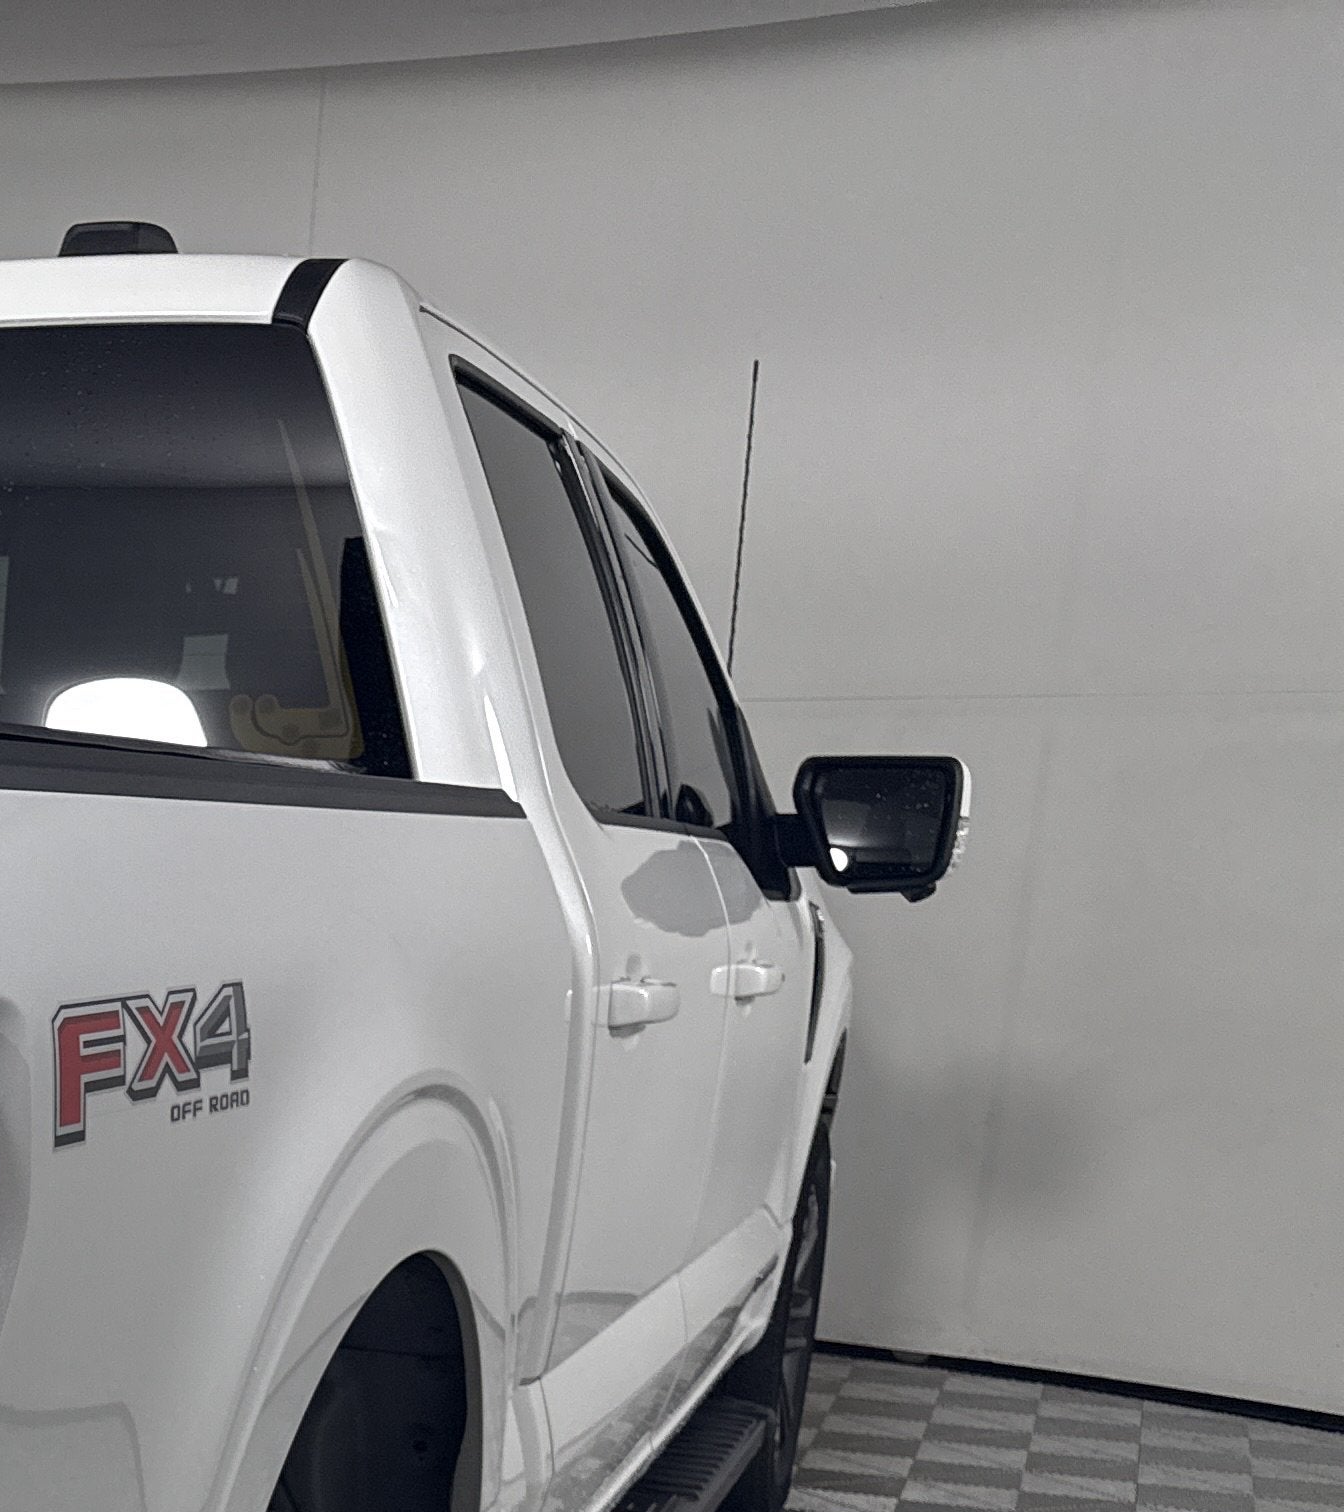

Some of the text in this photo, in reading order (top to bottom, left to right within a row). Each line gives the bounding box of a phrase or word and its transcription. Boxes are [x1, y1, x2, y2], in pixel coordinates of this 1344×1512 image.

[51, 980, 251, 1148] FX4
[170, 1089, 250, 1123] OFF ROAD
